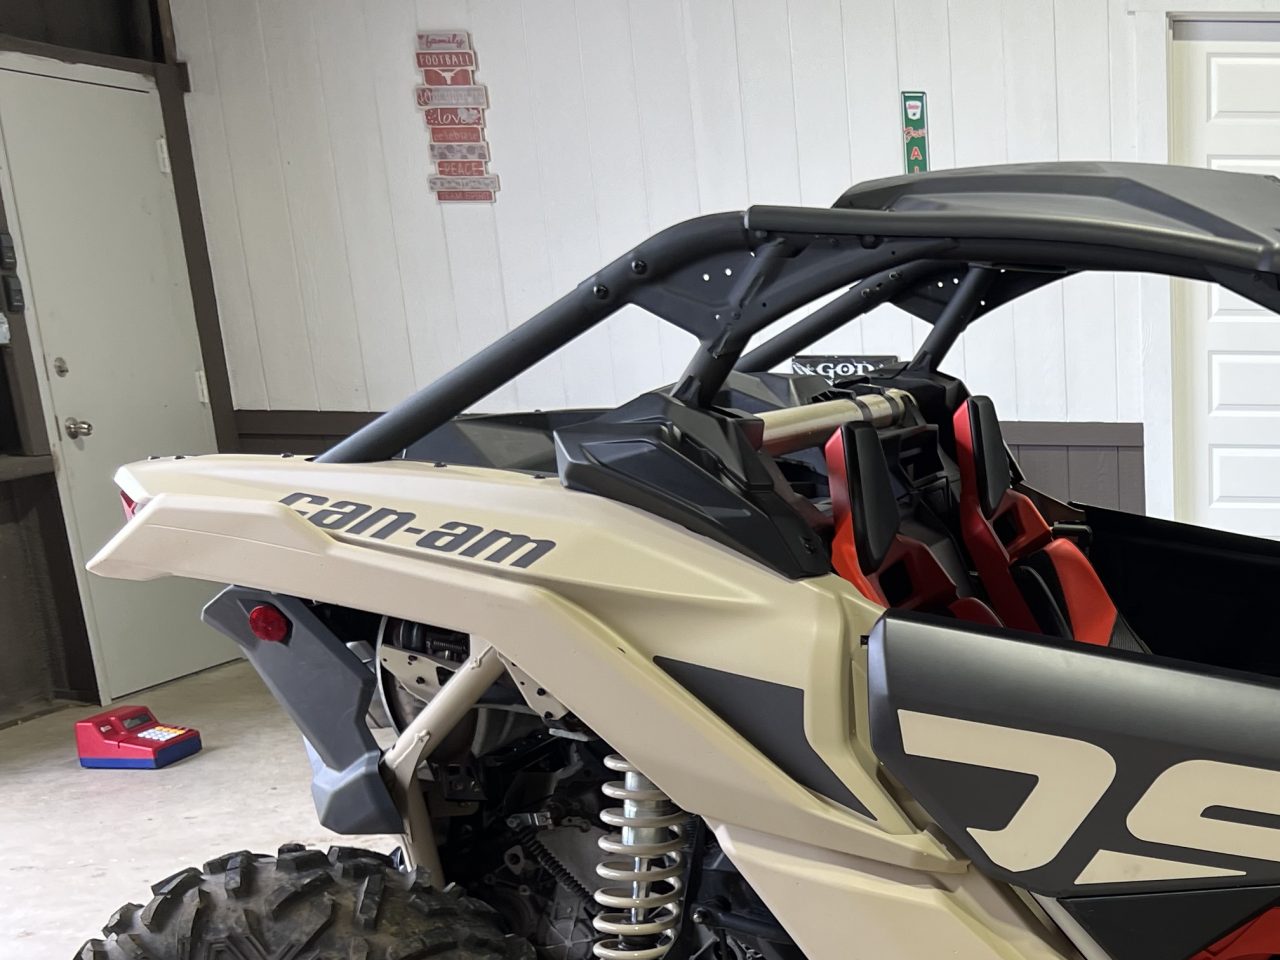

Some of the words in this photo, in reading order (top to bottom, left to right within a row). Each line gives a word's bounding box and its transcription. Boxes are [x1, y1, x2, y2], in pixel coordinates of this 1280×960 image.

[419, 54, 472, 66] FOOTBALL
[444, 162, 479, 175] PEACE
[278, 492, 556, 569] can-am
